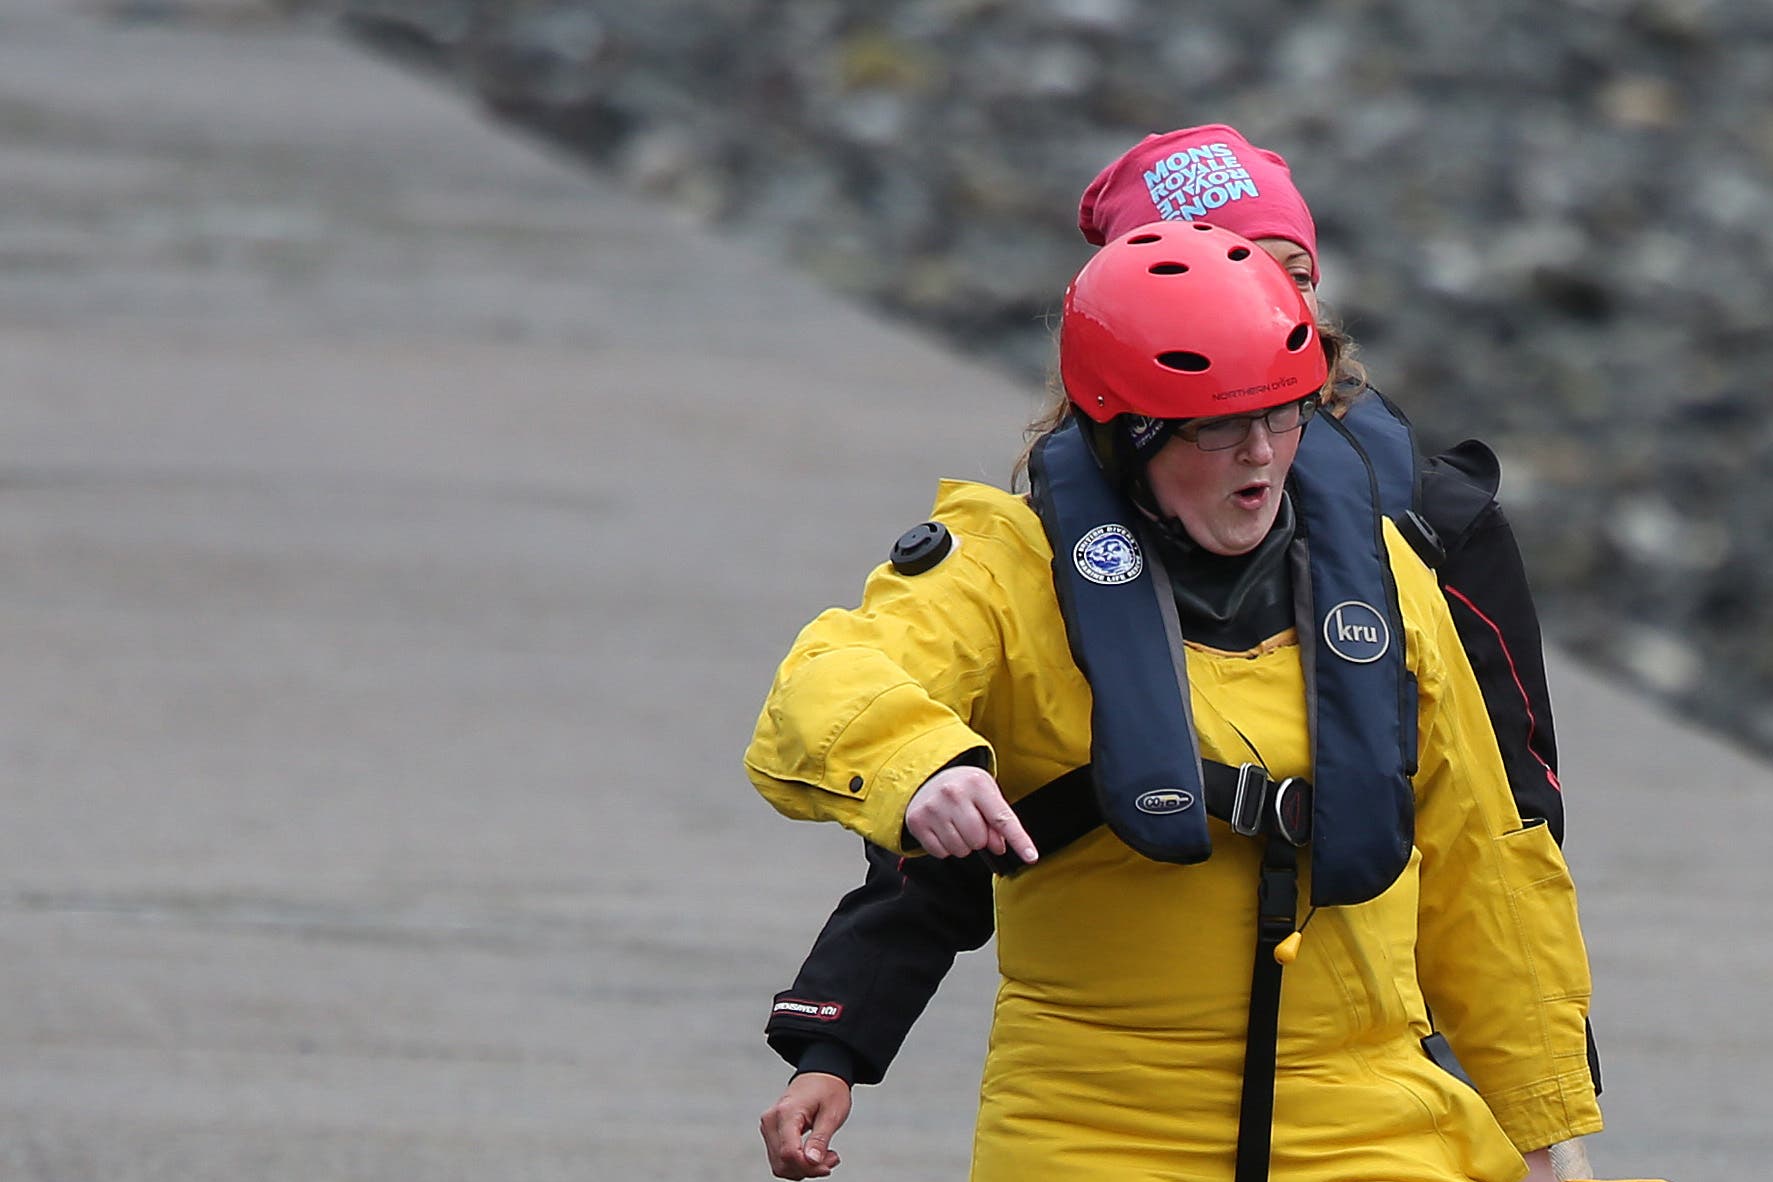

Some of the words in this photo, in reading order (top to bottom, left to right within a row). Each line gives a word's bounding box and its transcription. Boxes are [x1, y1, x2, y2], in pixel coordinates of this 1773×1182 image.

[1143, 143, 1233, 189] MONS
[1150, 156, 1242, 204] ROYALE
[1156, 168, 1250, 220] ROYALE
[1335, 608, 1378, 643] kru
